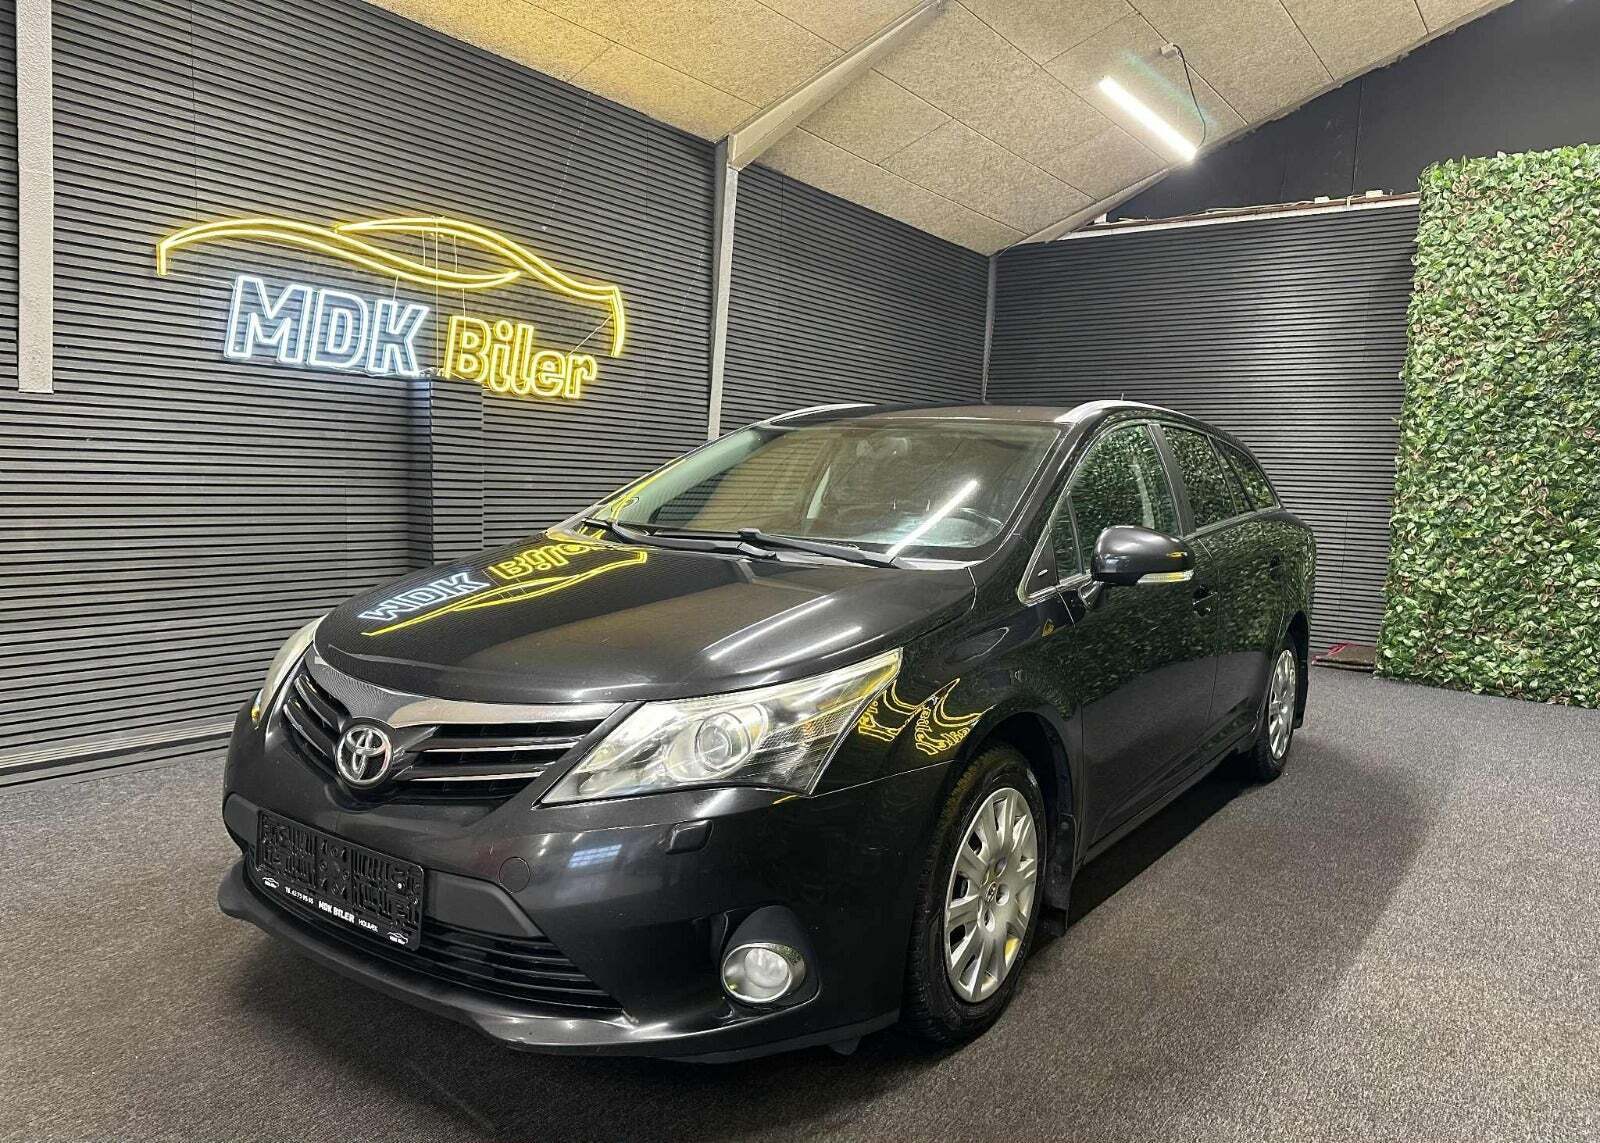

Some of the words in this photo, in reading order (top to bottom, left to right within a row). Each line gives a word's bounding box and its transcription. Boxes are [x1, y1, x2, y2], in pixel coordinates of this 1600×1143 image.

[224, 274, 430, 377] MDK
[444, 315, 598, 399] Biler
[333, 906, 355, 924] BILER
